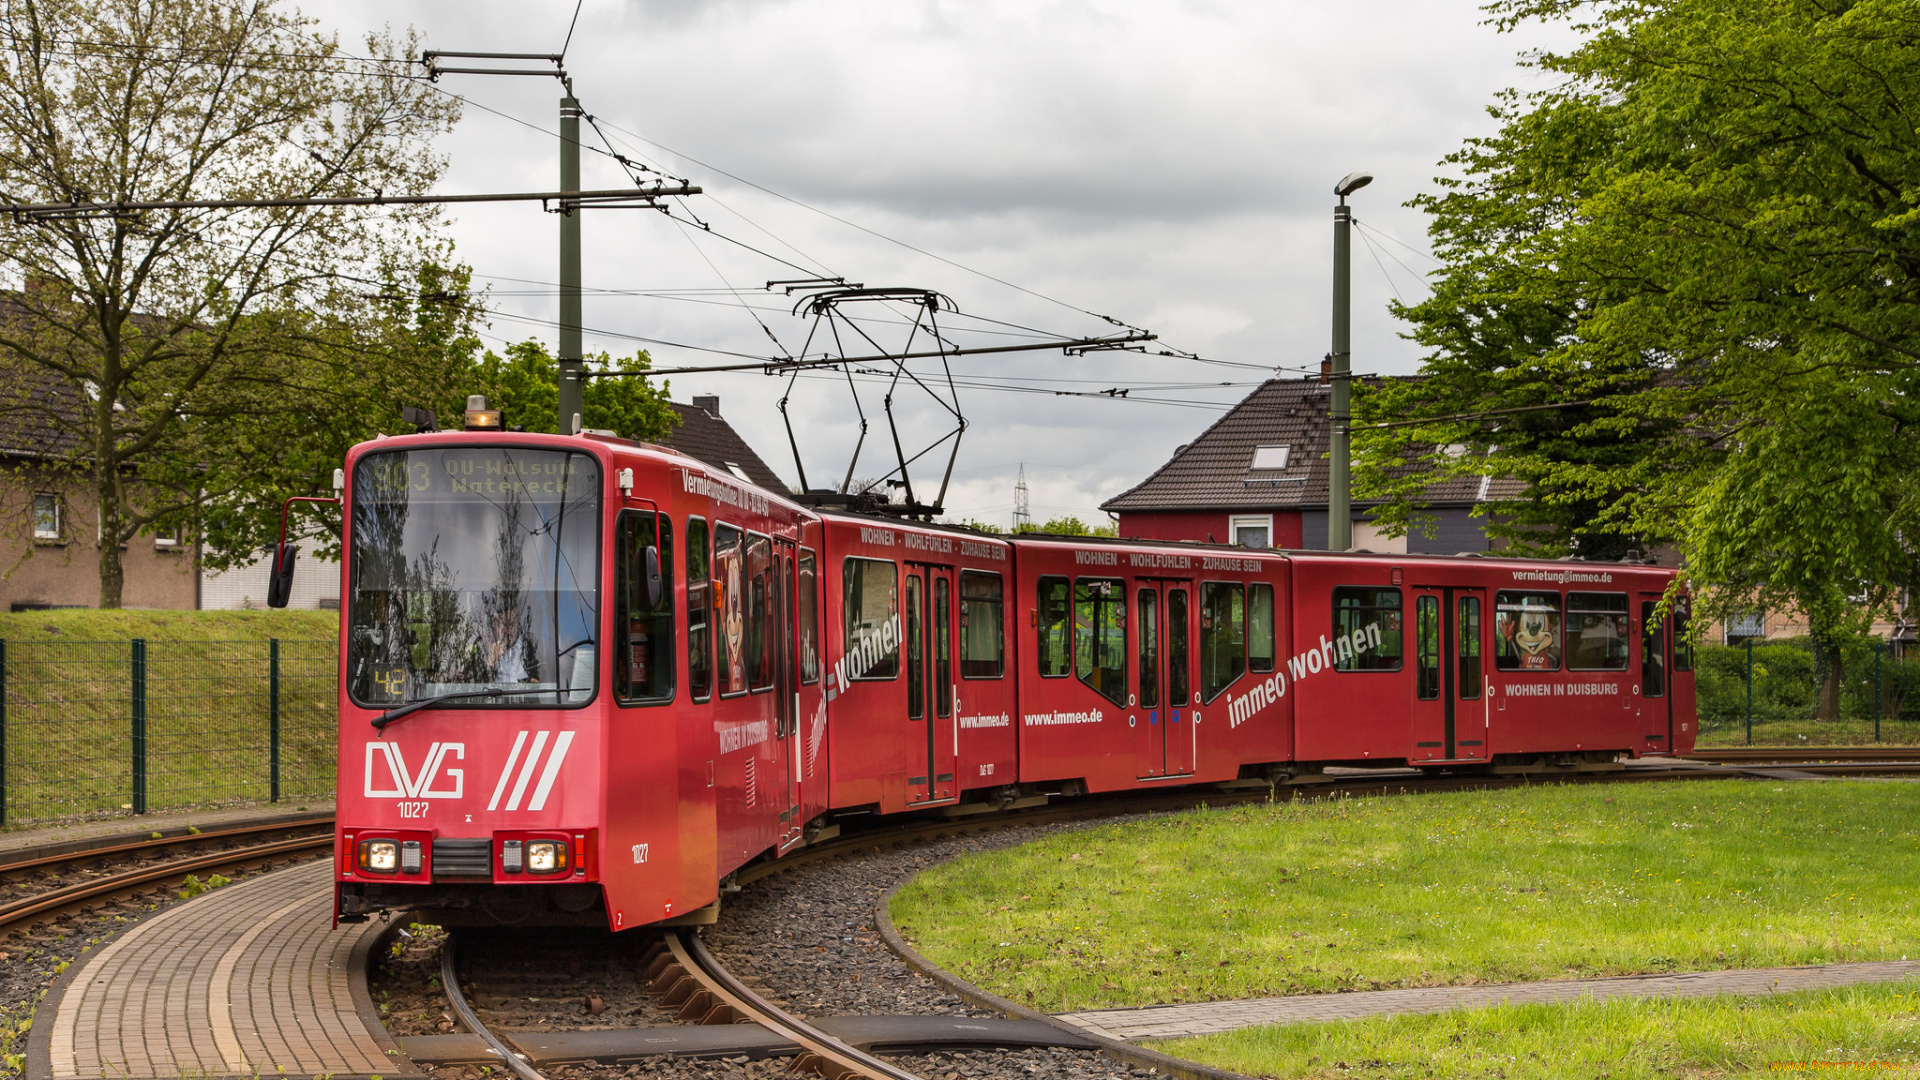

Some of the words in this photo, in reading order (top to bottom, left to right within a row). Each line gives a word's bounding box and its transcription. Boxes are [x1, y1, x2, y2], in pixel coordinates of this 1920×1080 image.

[375, 461, 430, 491] 903
[452, 477, 569, 493] Watereck
[860, 527, 895, 546] WOHNEN
[904, 532, 952, 553] WOHLFÜHLEN
[960, 541, 990, 559] ZUHAUSE
[991, 545, 1006, 560] SEIN
[1075, 550, 1117, 566] WOHNEN
[1130, 553, 1191, 569] WOHLFÜHLEN
[1202, 557, 1241, 571] ZUHAUSE
[1243, 560, 1262, 573] SEIN
[1512, 569, 1612, 584] vermietung@immeo.de
[834, 612, 903, 694] wohnen
[375, 669, 405, 695] 42
[1226, 671, 1286, 729] immeo
[1286, 622, 1382, 682] wohnen
[1505, 683, 1551, 696] WOHNEN
[1553, 683, 1564, 695] IN
[1567, 682, 1618, 695] DUISBURG
[960, 711, 1009, 729] www.immeo.de
[1024, 707, 1103, 726] www.immeo.de
[364, 741, 465, 799] DVG
[397, 801, 429, 818] 1027
[631, 843, 649, 864] 1027
